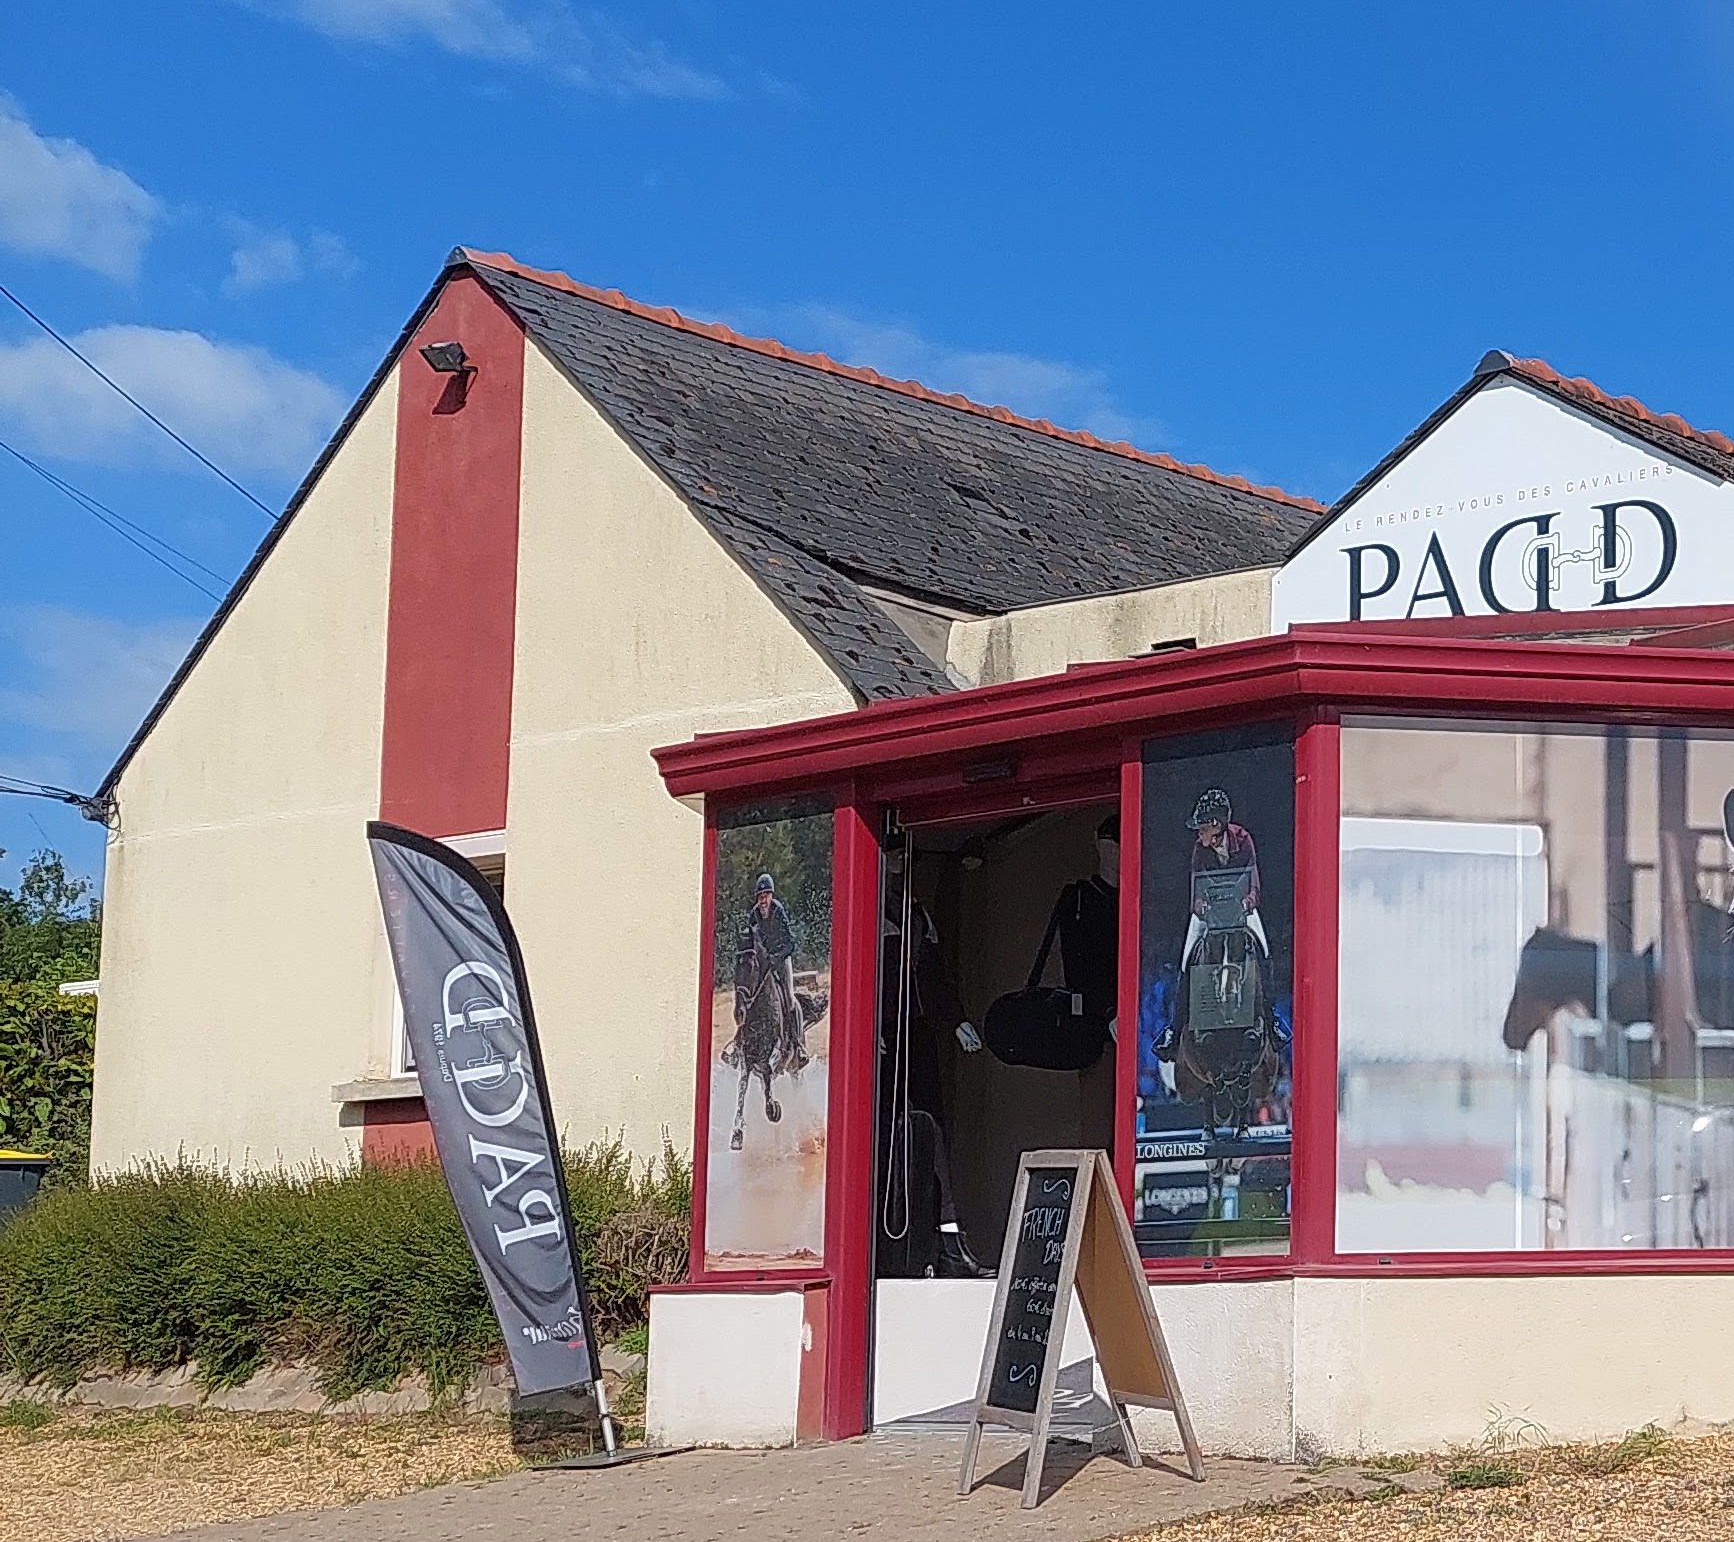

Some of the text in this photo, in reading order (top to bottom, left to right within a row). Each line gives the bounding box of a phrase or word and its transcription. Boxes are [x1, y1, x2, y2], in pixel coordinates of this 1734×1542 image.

[1344, 463, 1675, 534] LE RENDEZ-VOUS DES CAVALIERS
[1136, 1142, 1206, 1159] LONGINES
[1022, 1207, 1064, 1242] FRENCH
